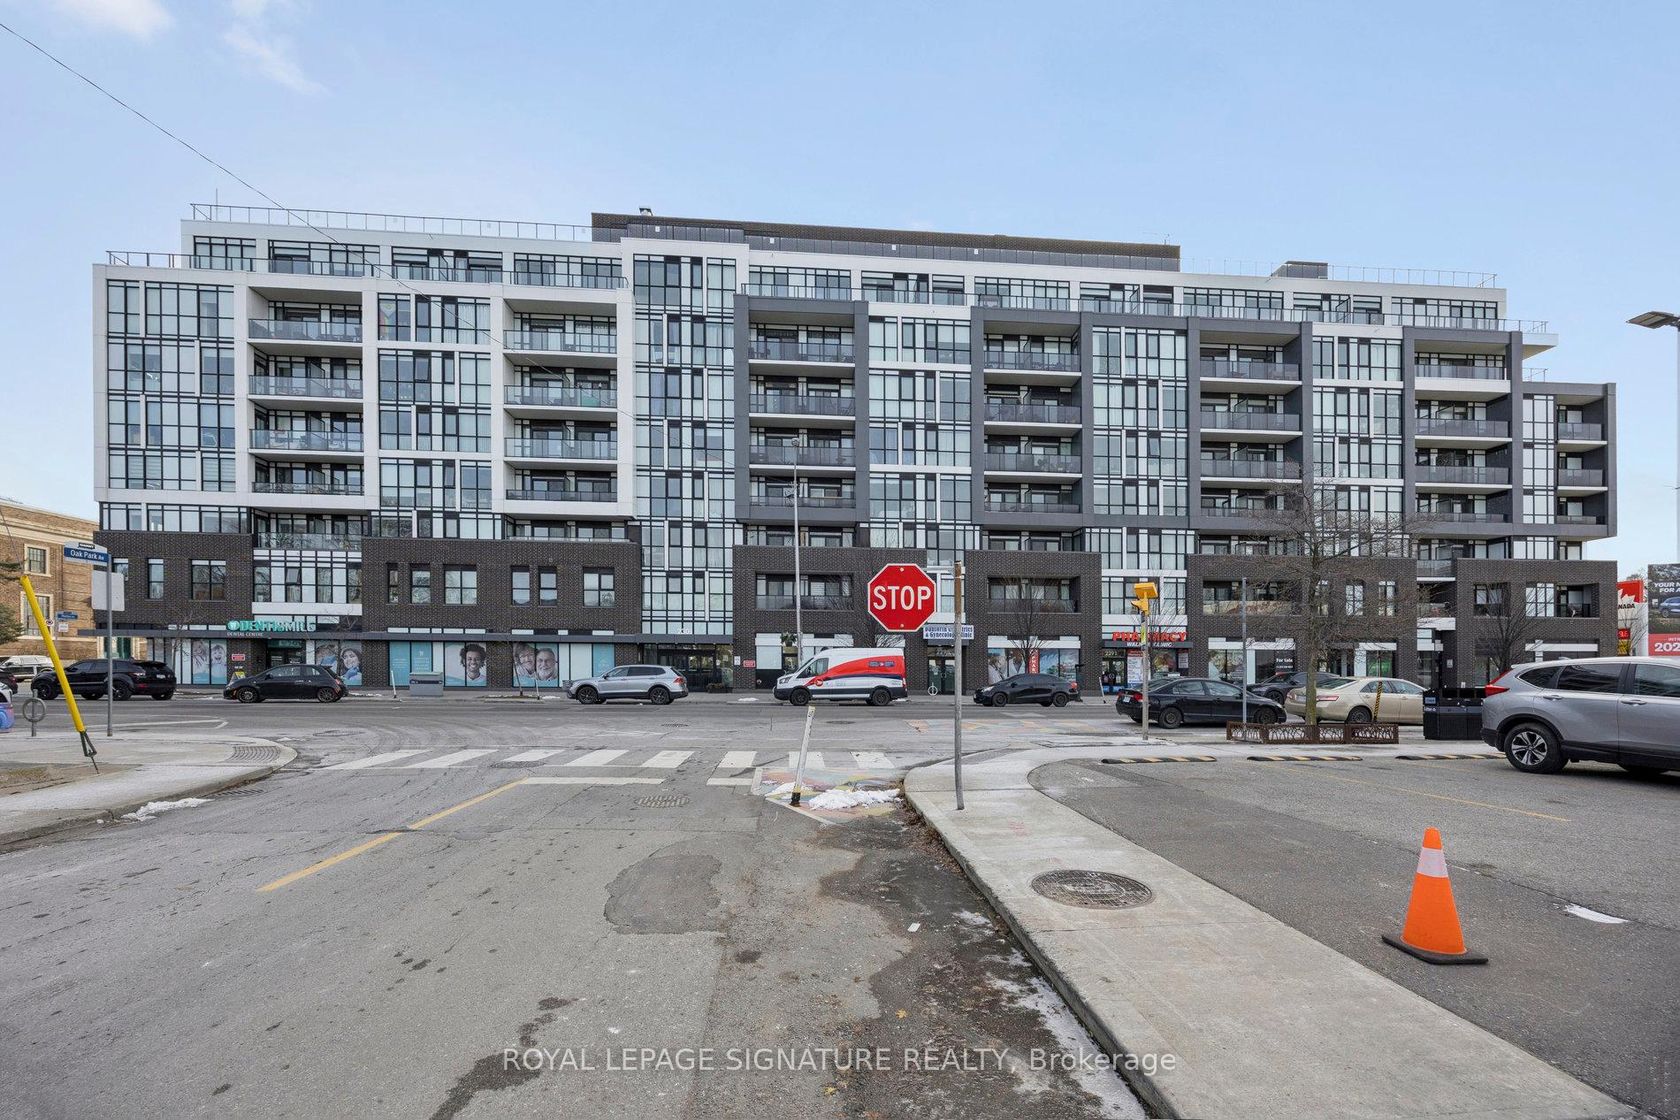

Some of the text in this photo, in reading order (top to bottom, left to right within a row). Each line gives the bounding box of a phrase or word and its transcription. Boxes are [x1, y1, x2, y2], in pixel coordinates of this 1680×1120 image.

[873, 585, 931, 610] STOP
[1112, 632, 1186, 641] PHAMACY
[1655, 643, 1680, 651] 202
